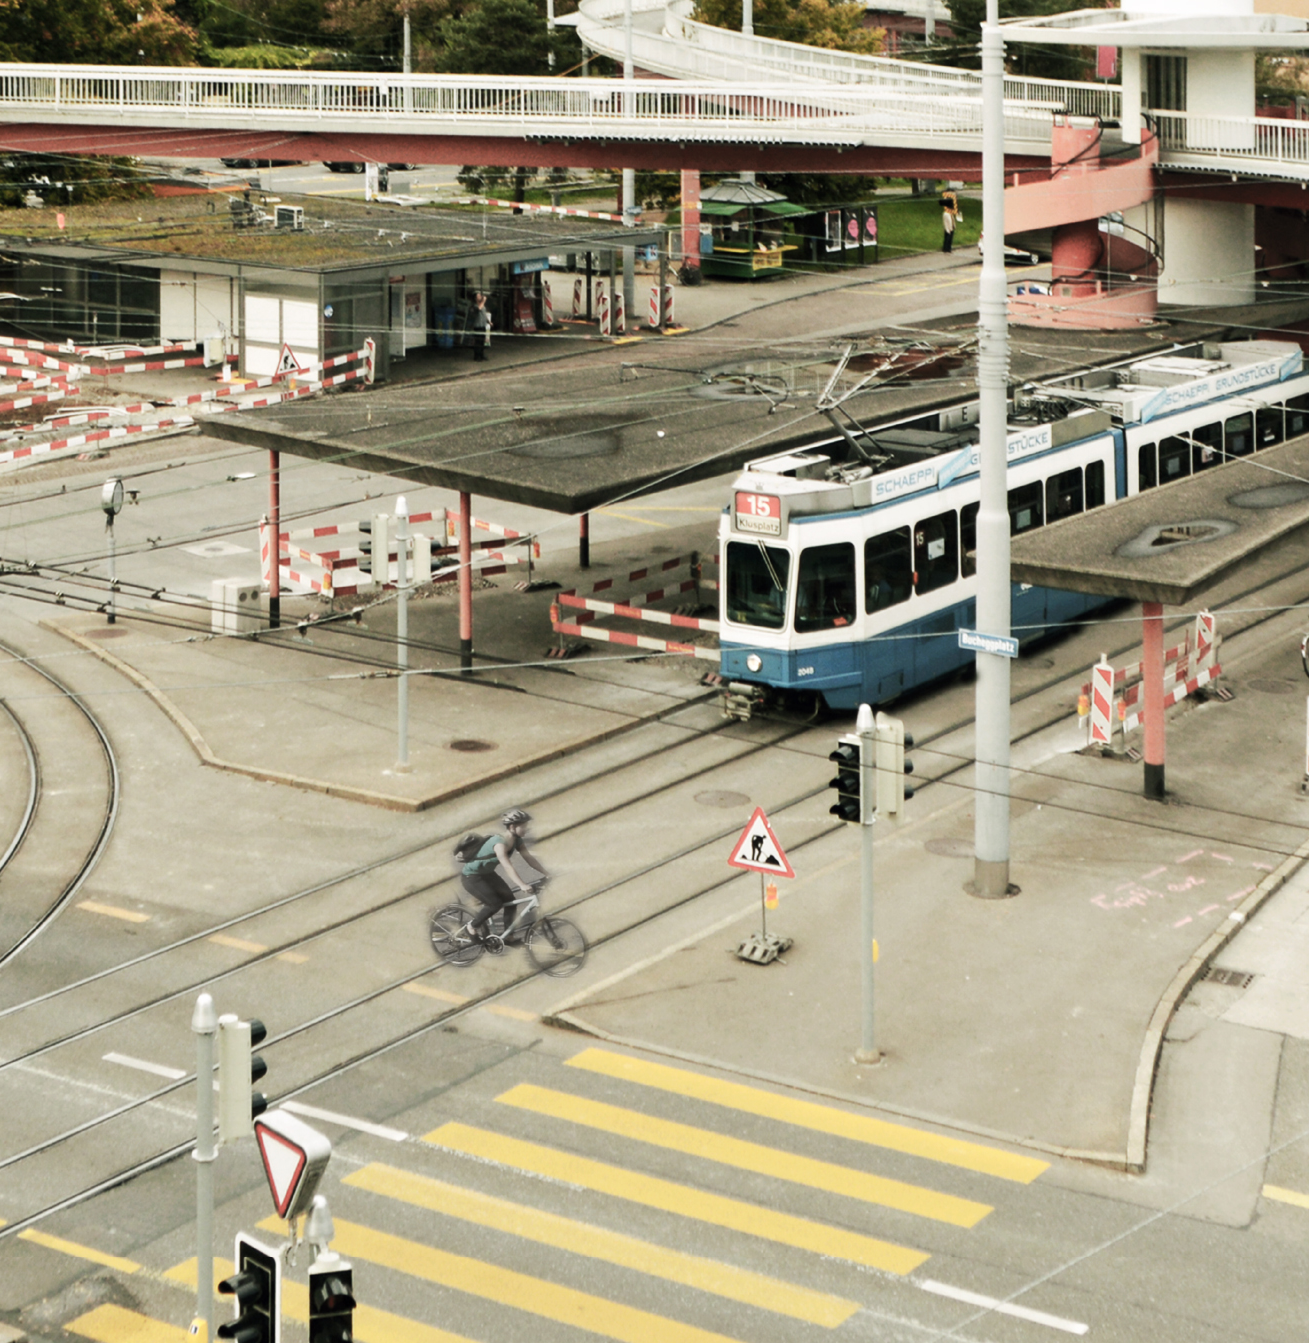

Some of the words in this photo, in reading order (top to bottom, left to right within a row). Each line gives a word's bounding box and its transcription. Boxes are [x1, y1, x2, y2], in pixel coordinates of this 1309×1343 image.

[1165, 383, 1209, 406] SCHAEPPI
[1215, 363, 1277, 390] GRUNDSTÜCKE
[876, 467, 936, 496] SCHAEPPI
[746, 494, 771, 517] 15
[739, 518, 780, 533] Klusplatz
[915, 531, 925, 546] 15
[962, 632, 1015, 654] Bucheggplatz
